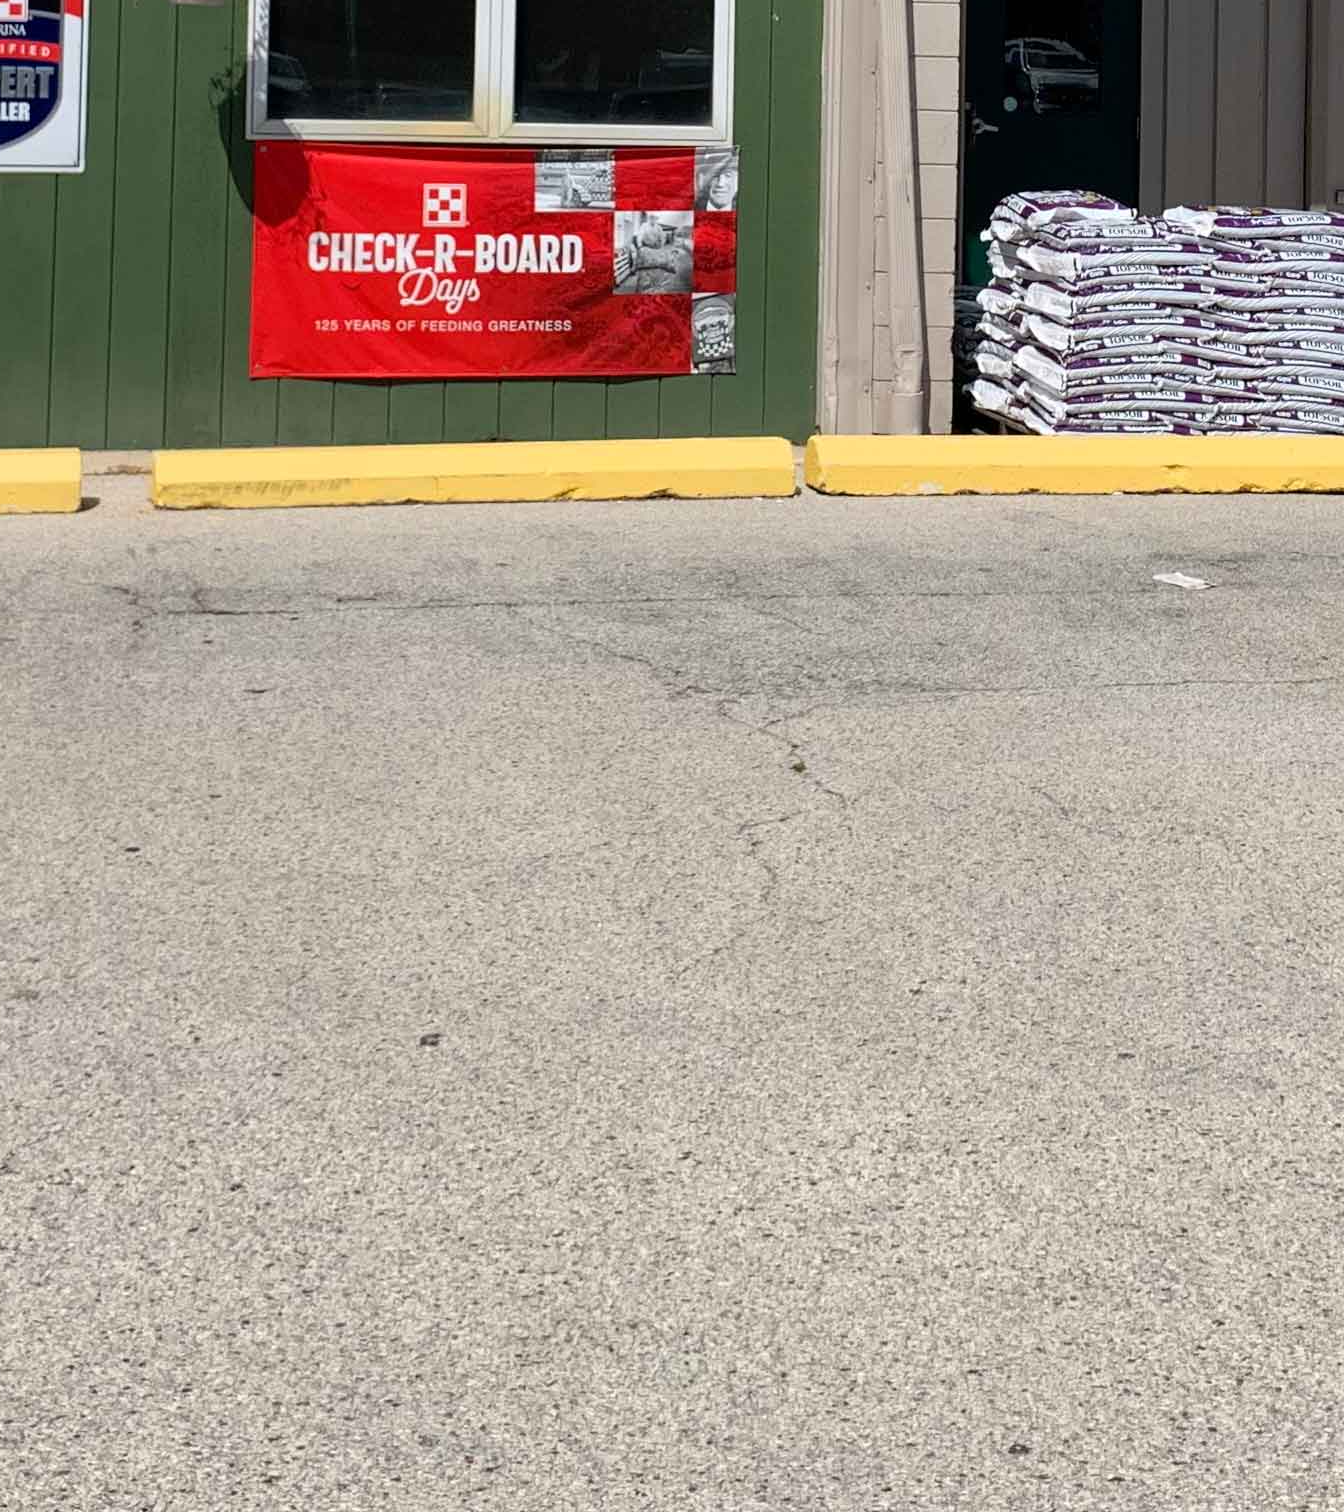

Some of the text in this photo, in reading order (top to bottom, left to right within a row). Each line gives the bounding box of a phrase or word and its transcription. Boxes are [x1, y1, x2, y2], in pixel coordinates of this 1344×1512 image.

[308, 231, 584, 273] CHECK-R-BOARD
[397, 267, 481, 315] Days
[314, 319, 573, 333] 125 YEARS OF FEEDING GREATNESS
[1305, 341, 1344, 353] TOPSOIL
[1304, 377, 1343, 389] TOPSOIL
